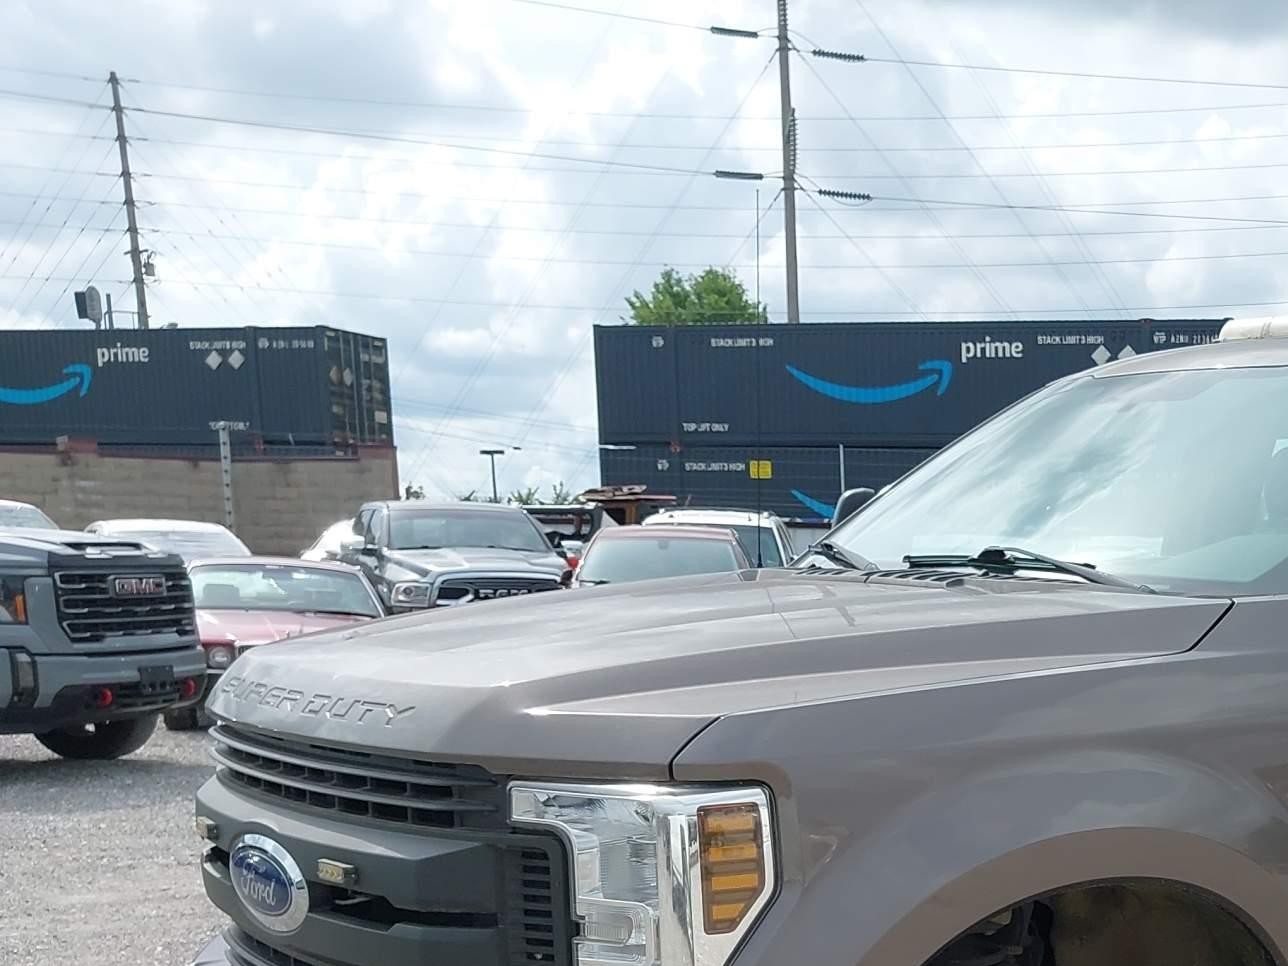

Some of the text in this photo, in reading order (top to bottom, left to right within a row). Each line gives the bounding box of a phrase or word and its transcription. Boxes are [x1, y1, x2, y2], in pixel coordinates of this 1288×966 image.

[97, 342, 150, 367] prime
[961, 336, 1023, 363] prime
[115, 578, 164, 595] GMC
[221, 676, 417, 728] SUPER DUTY
[241, 858, 278, 906] Ford
